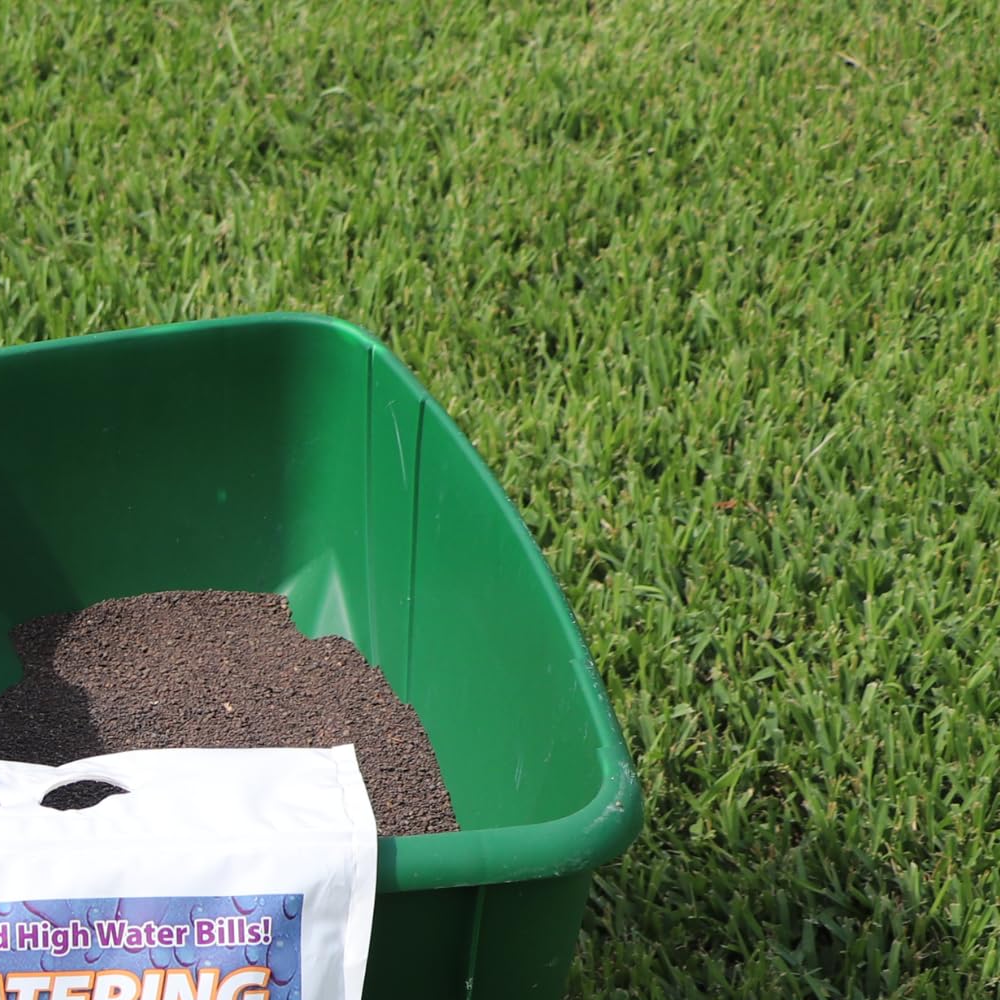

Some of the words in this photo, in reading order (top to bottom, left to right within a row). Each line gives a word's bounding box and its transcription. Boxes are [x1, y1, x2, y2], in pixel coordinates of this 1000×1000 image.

[16, 919, 91, 957] High
[95, 919, 189, 948] Water
[194, 917, 272, 946] Bills!
